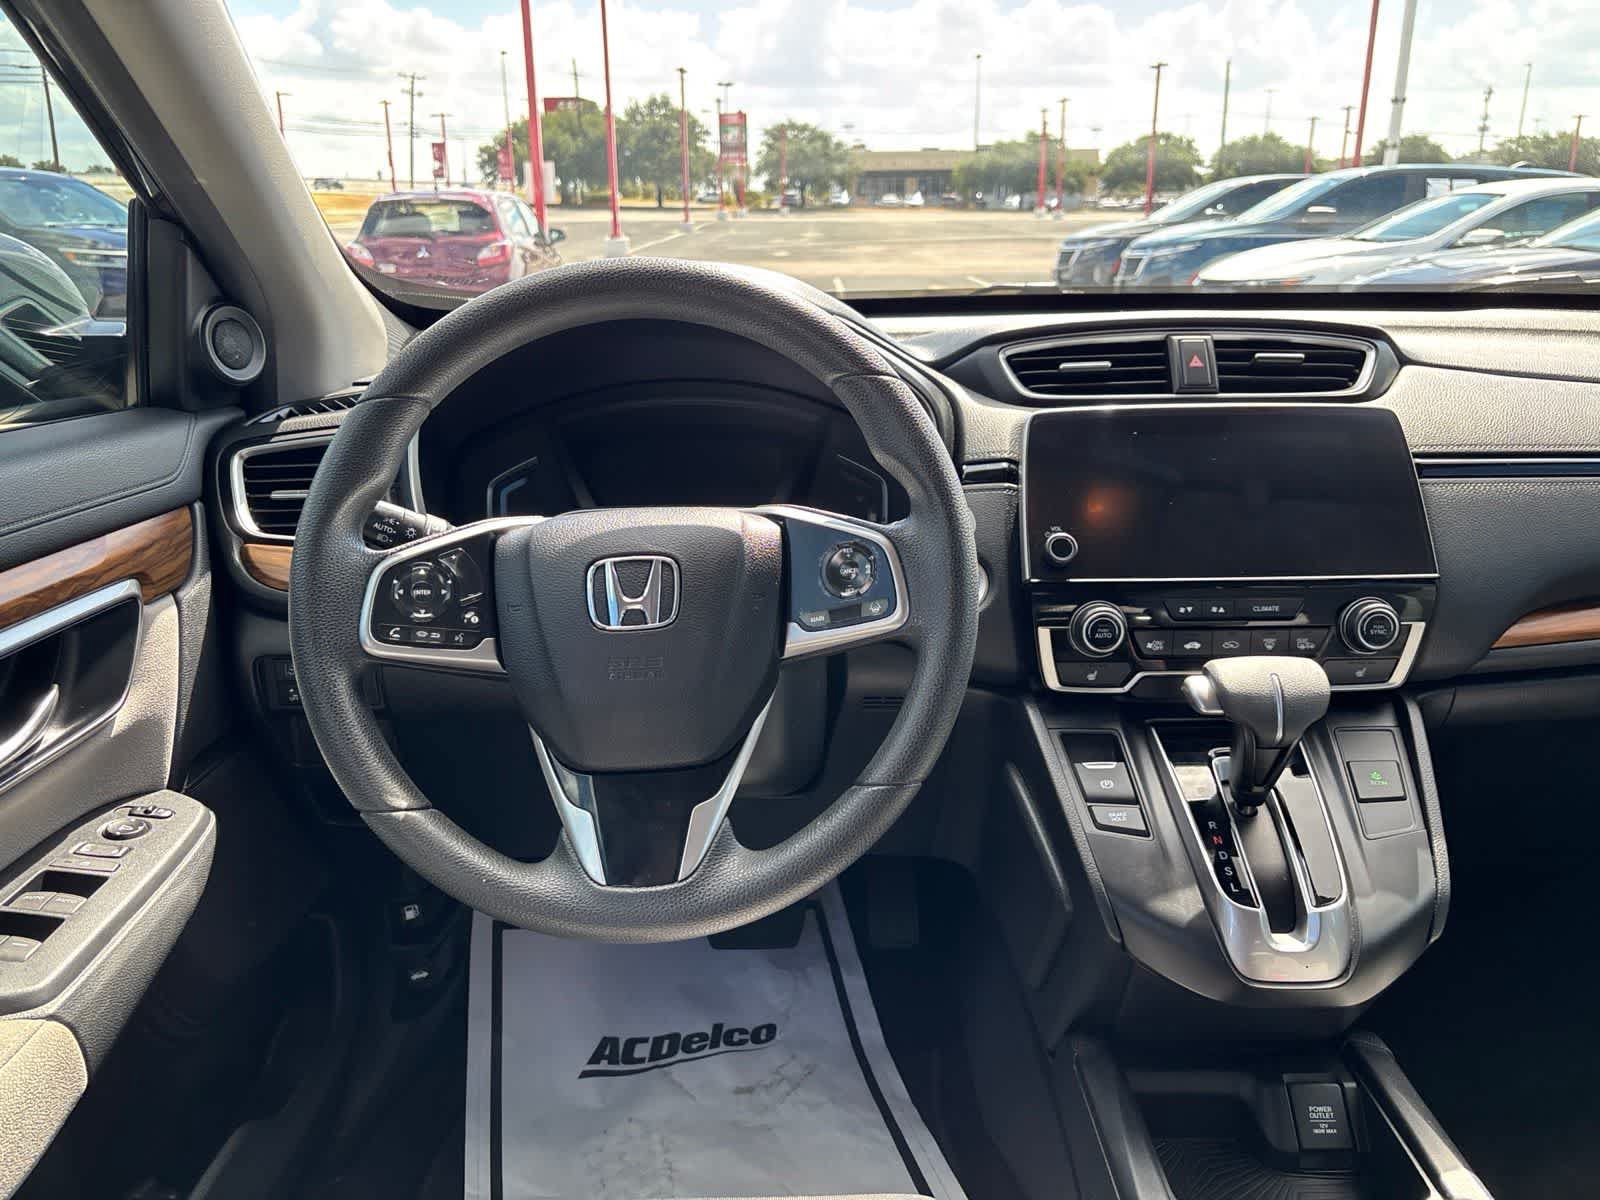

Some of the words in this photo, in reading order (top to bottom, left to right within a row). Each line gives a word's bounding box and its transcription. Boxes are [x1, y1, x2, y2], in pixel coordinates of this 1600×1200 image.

[373, 522, 393, 534] AUTO
[1208, 821, 1217, 829] R
[1212, 835, 1222, 845] N
[1218, 851, 1228, 860] D
[1224, 866, 1232, 876] S
[1230, 882, 1239, 892] L
[587, 1023, 777, 1065] ACDelco
